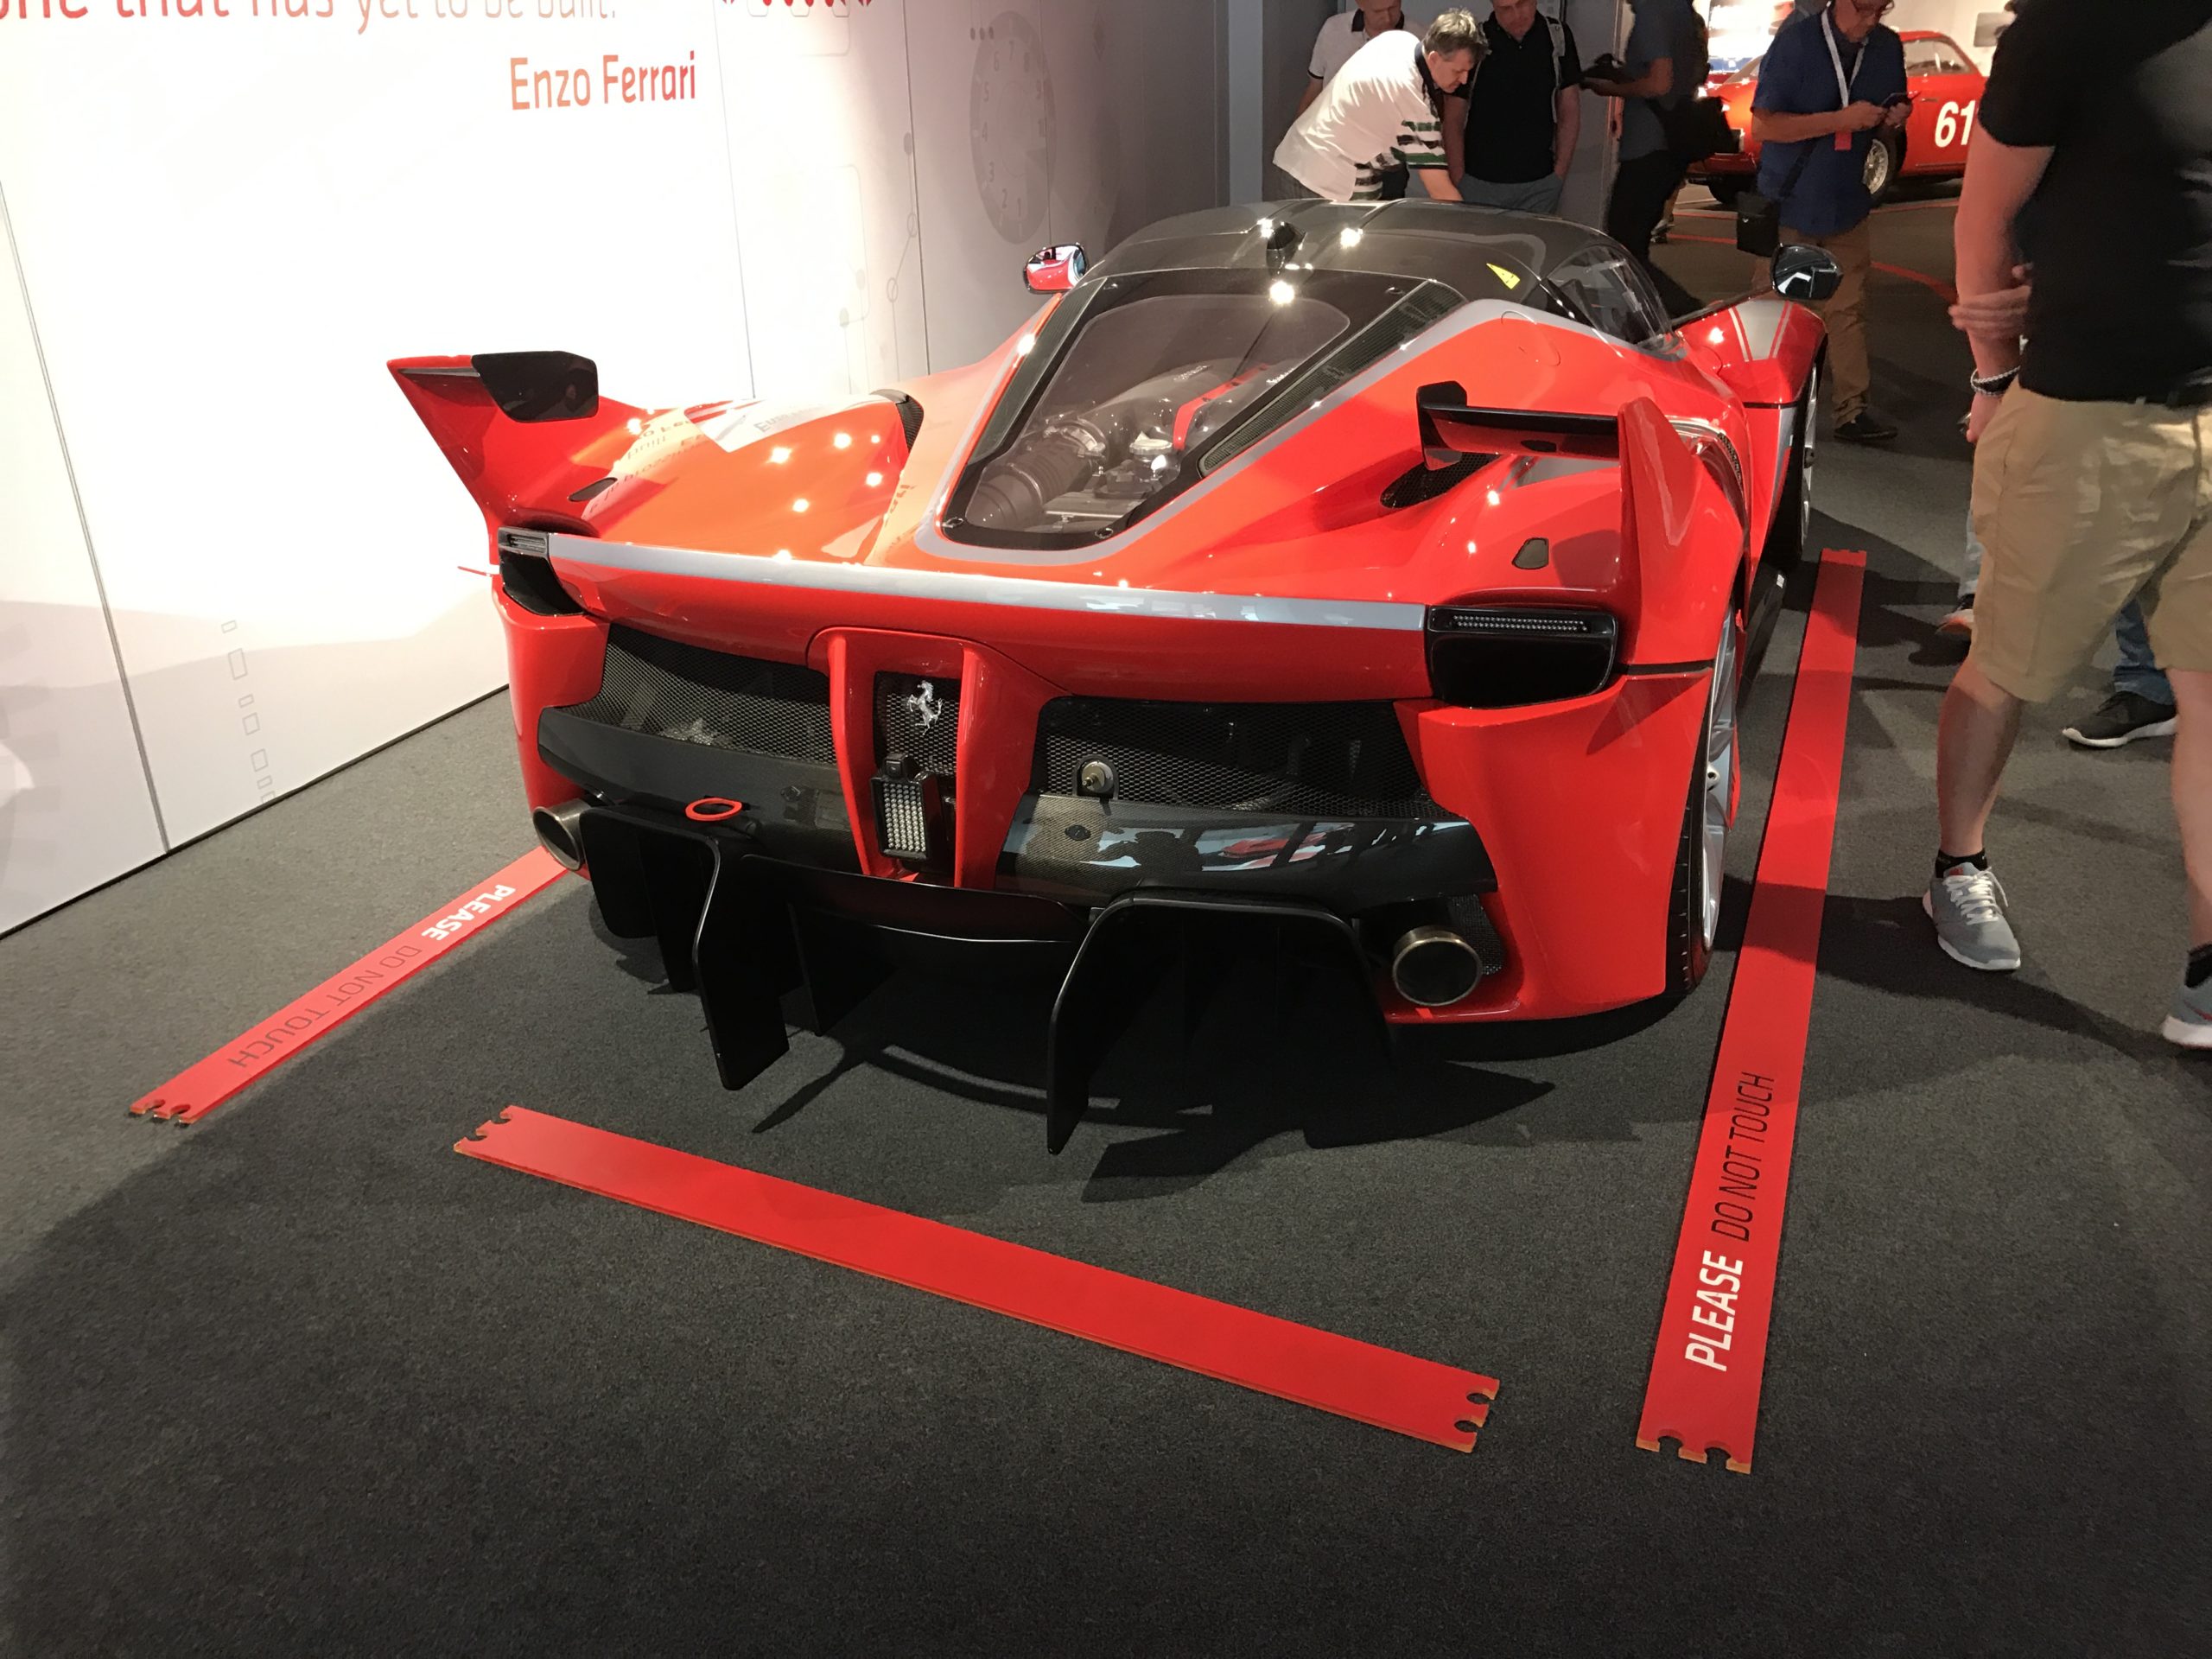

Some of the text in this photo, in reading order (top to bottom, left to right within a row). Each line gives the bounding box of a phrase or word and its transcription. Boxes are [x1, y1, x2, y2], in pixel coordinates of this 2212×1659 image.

[510, 50, 695, 110] Enzo Ferrari
[1935, 99, 1976, 149] 61
[227, 883, 516, 1068] PLEASE DO NOT TOUCH
[1684, 1071, 1775, 1372] PLEASE DO NOT TOUCH
